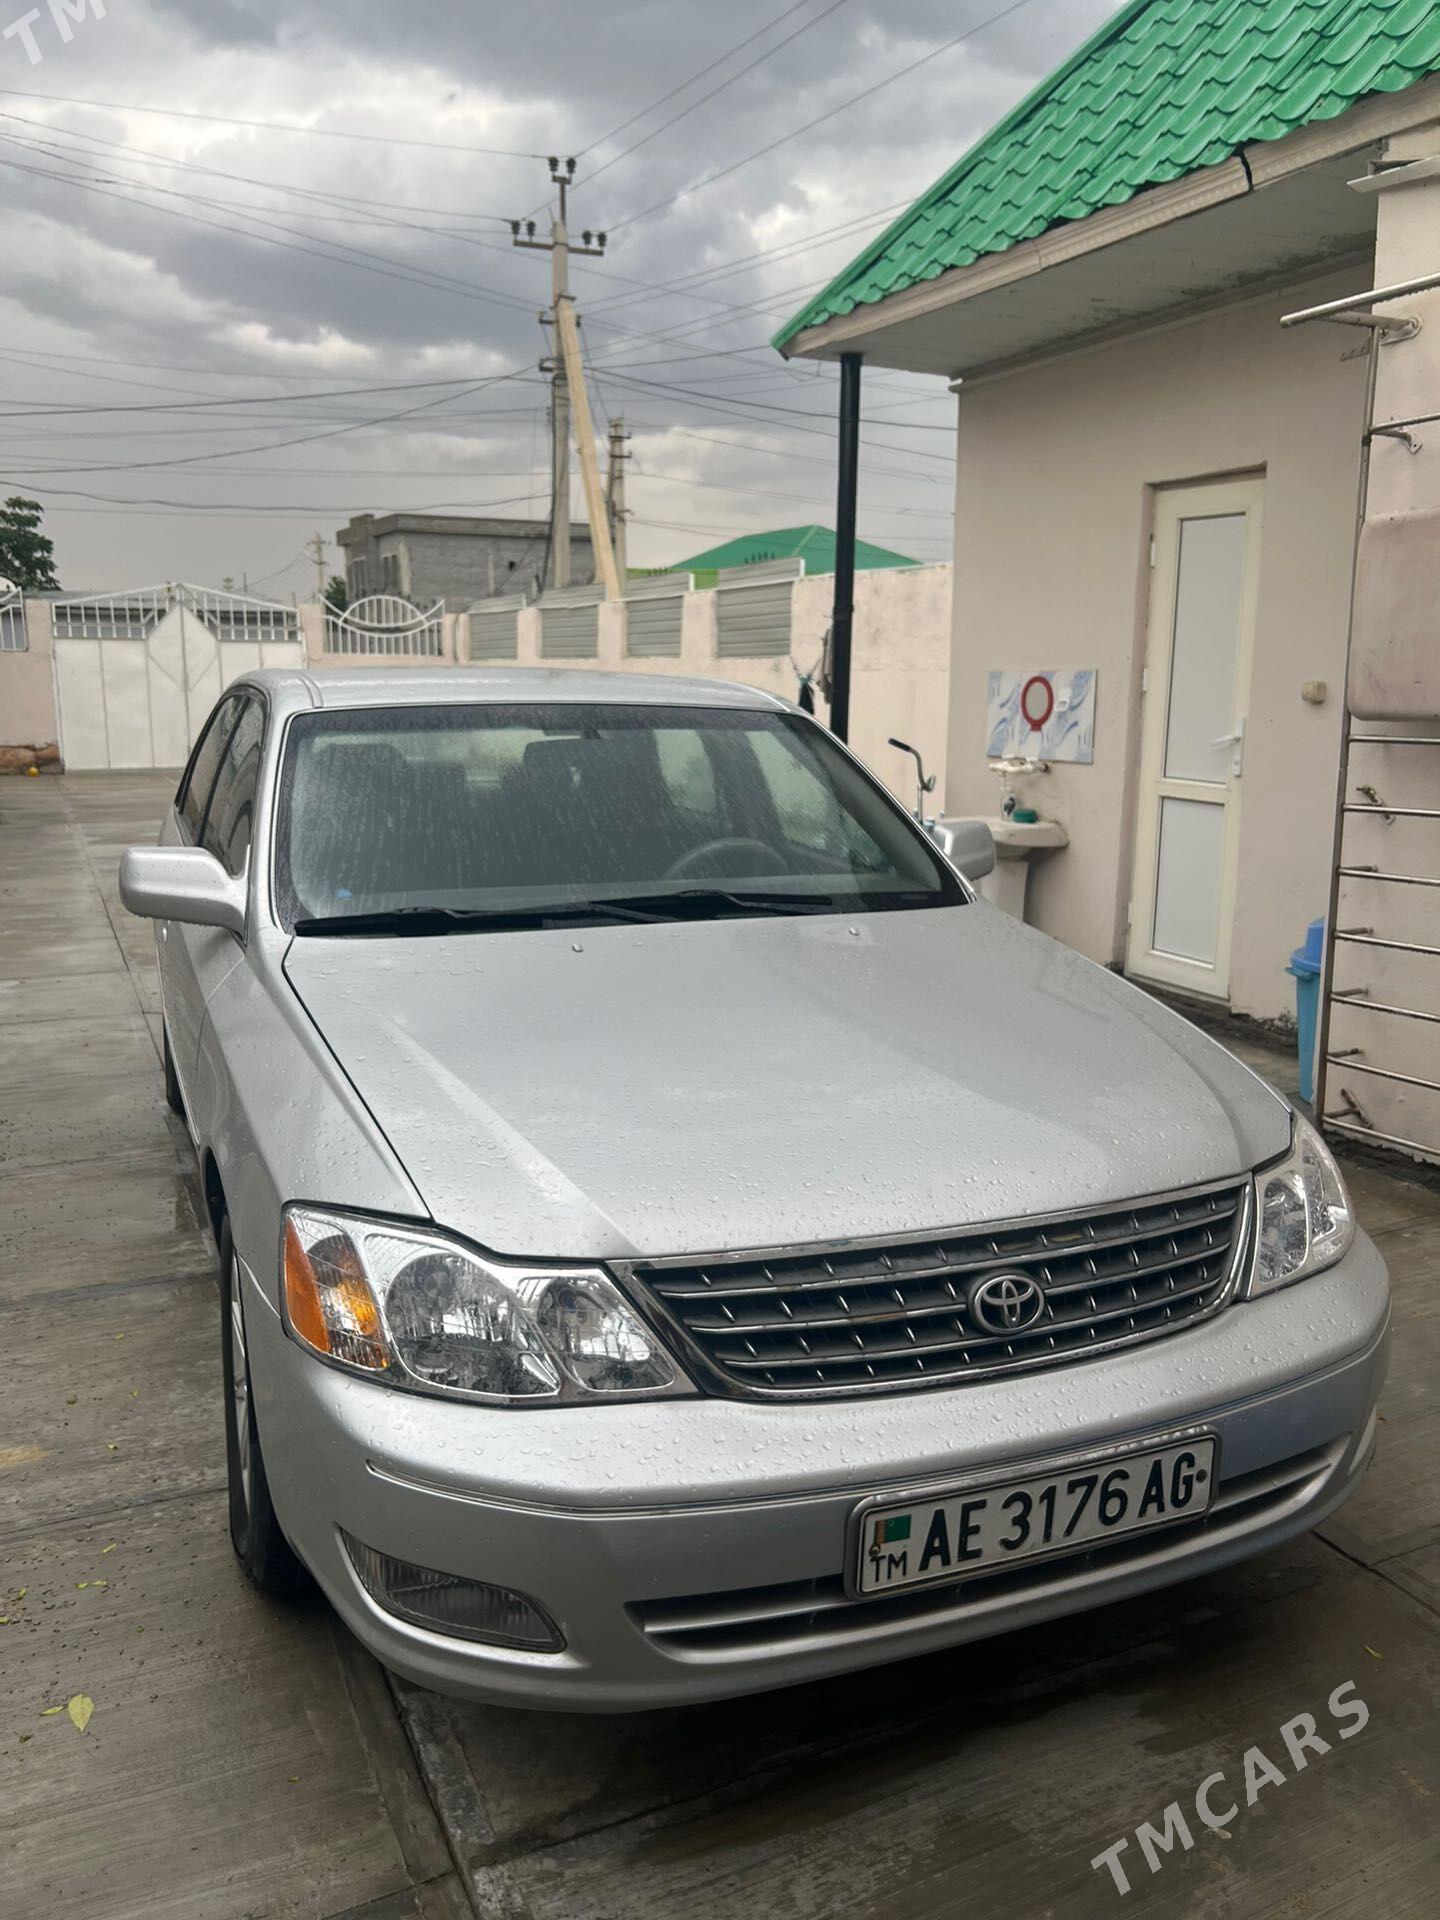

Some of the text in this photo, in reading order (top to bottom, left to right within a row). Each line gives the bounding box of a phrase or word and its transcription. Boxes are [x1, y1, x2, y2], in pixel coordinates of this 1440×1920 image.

[918, 1452, 1196, 1571] AE 3176 AG
[870, 1551, 907, 1583] TM
